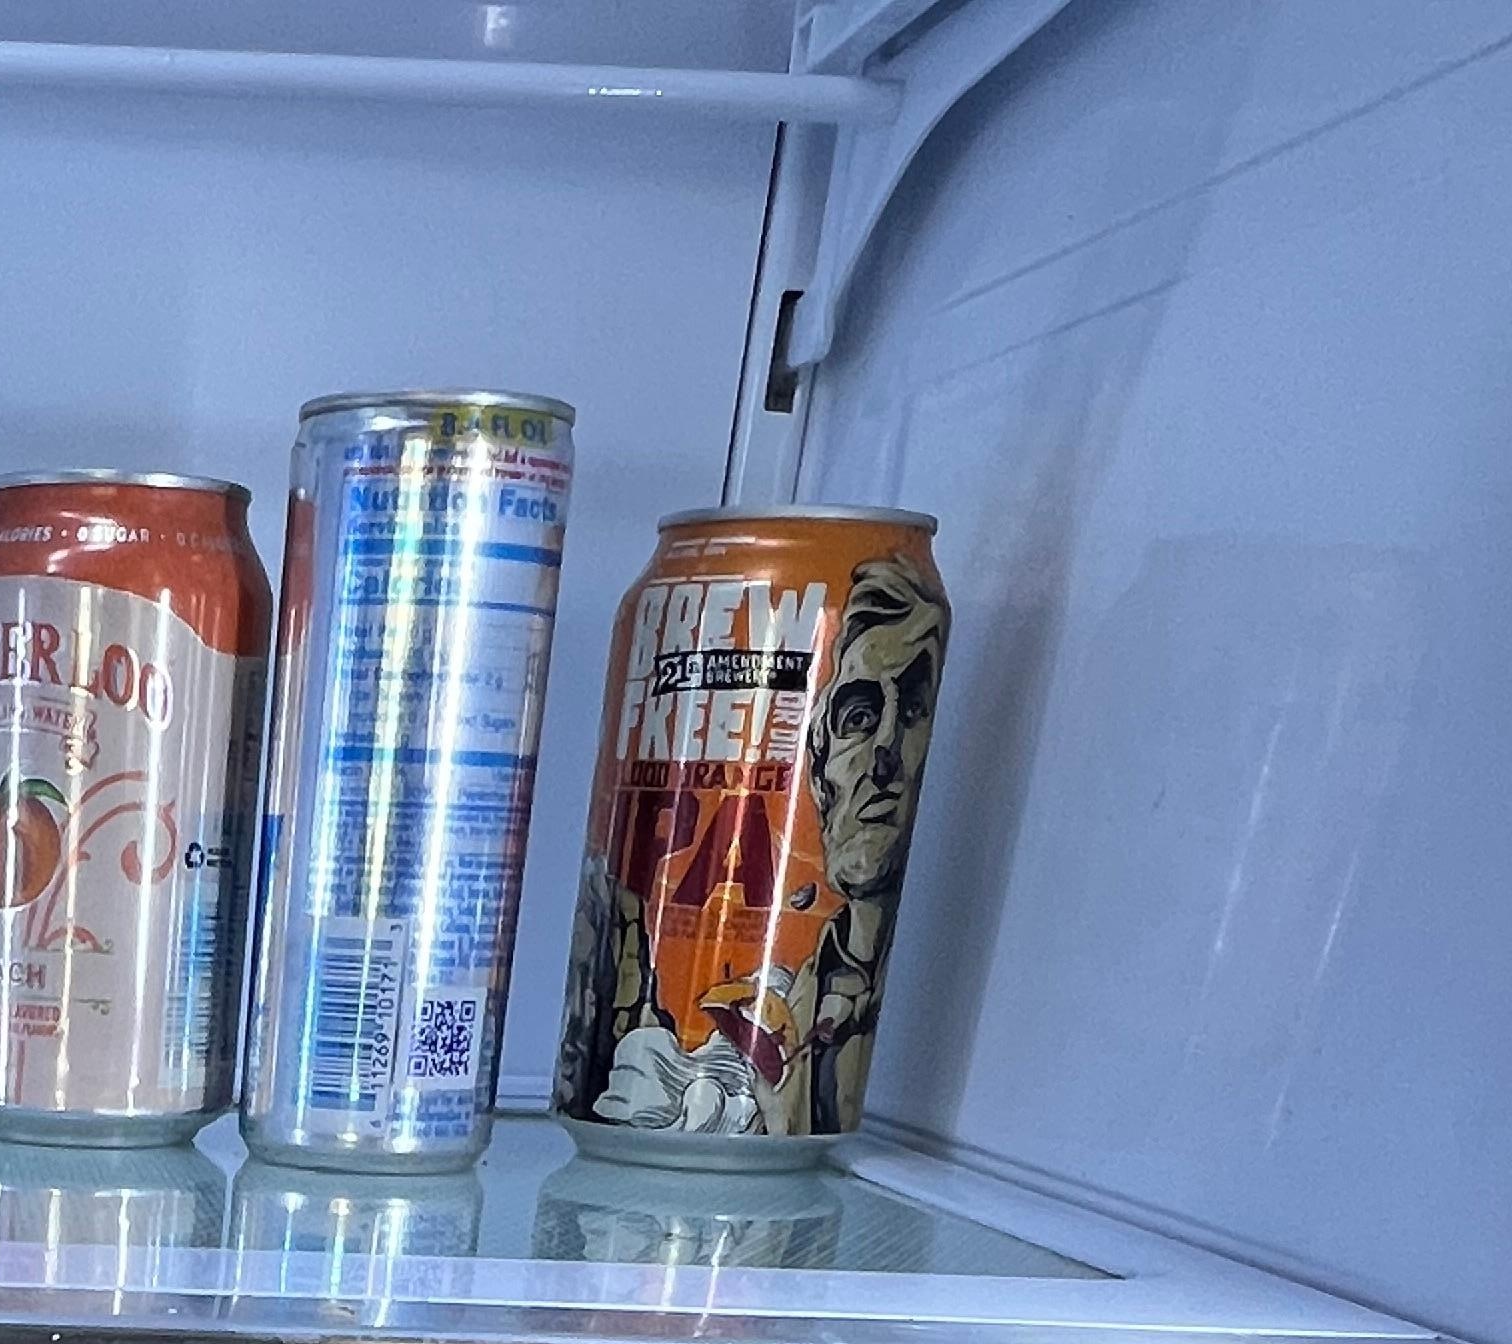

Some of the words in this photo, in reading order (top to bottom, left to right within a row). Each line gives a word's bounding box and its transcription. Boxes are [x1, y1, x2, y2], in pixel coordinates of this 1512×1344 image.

[92, 526, 150, 544] SUGAR
[626, 581, 828, 681] BREW
[376, 959, 399, 1021] 10171
[369, 1031, 391, 1092] 11269
